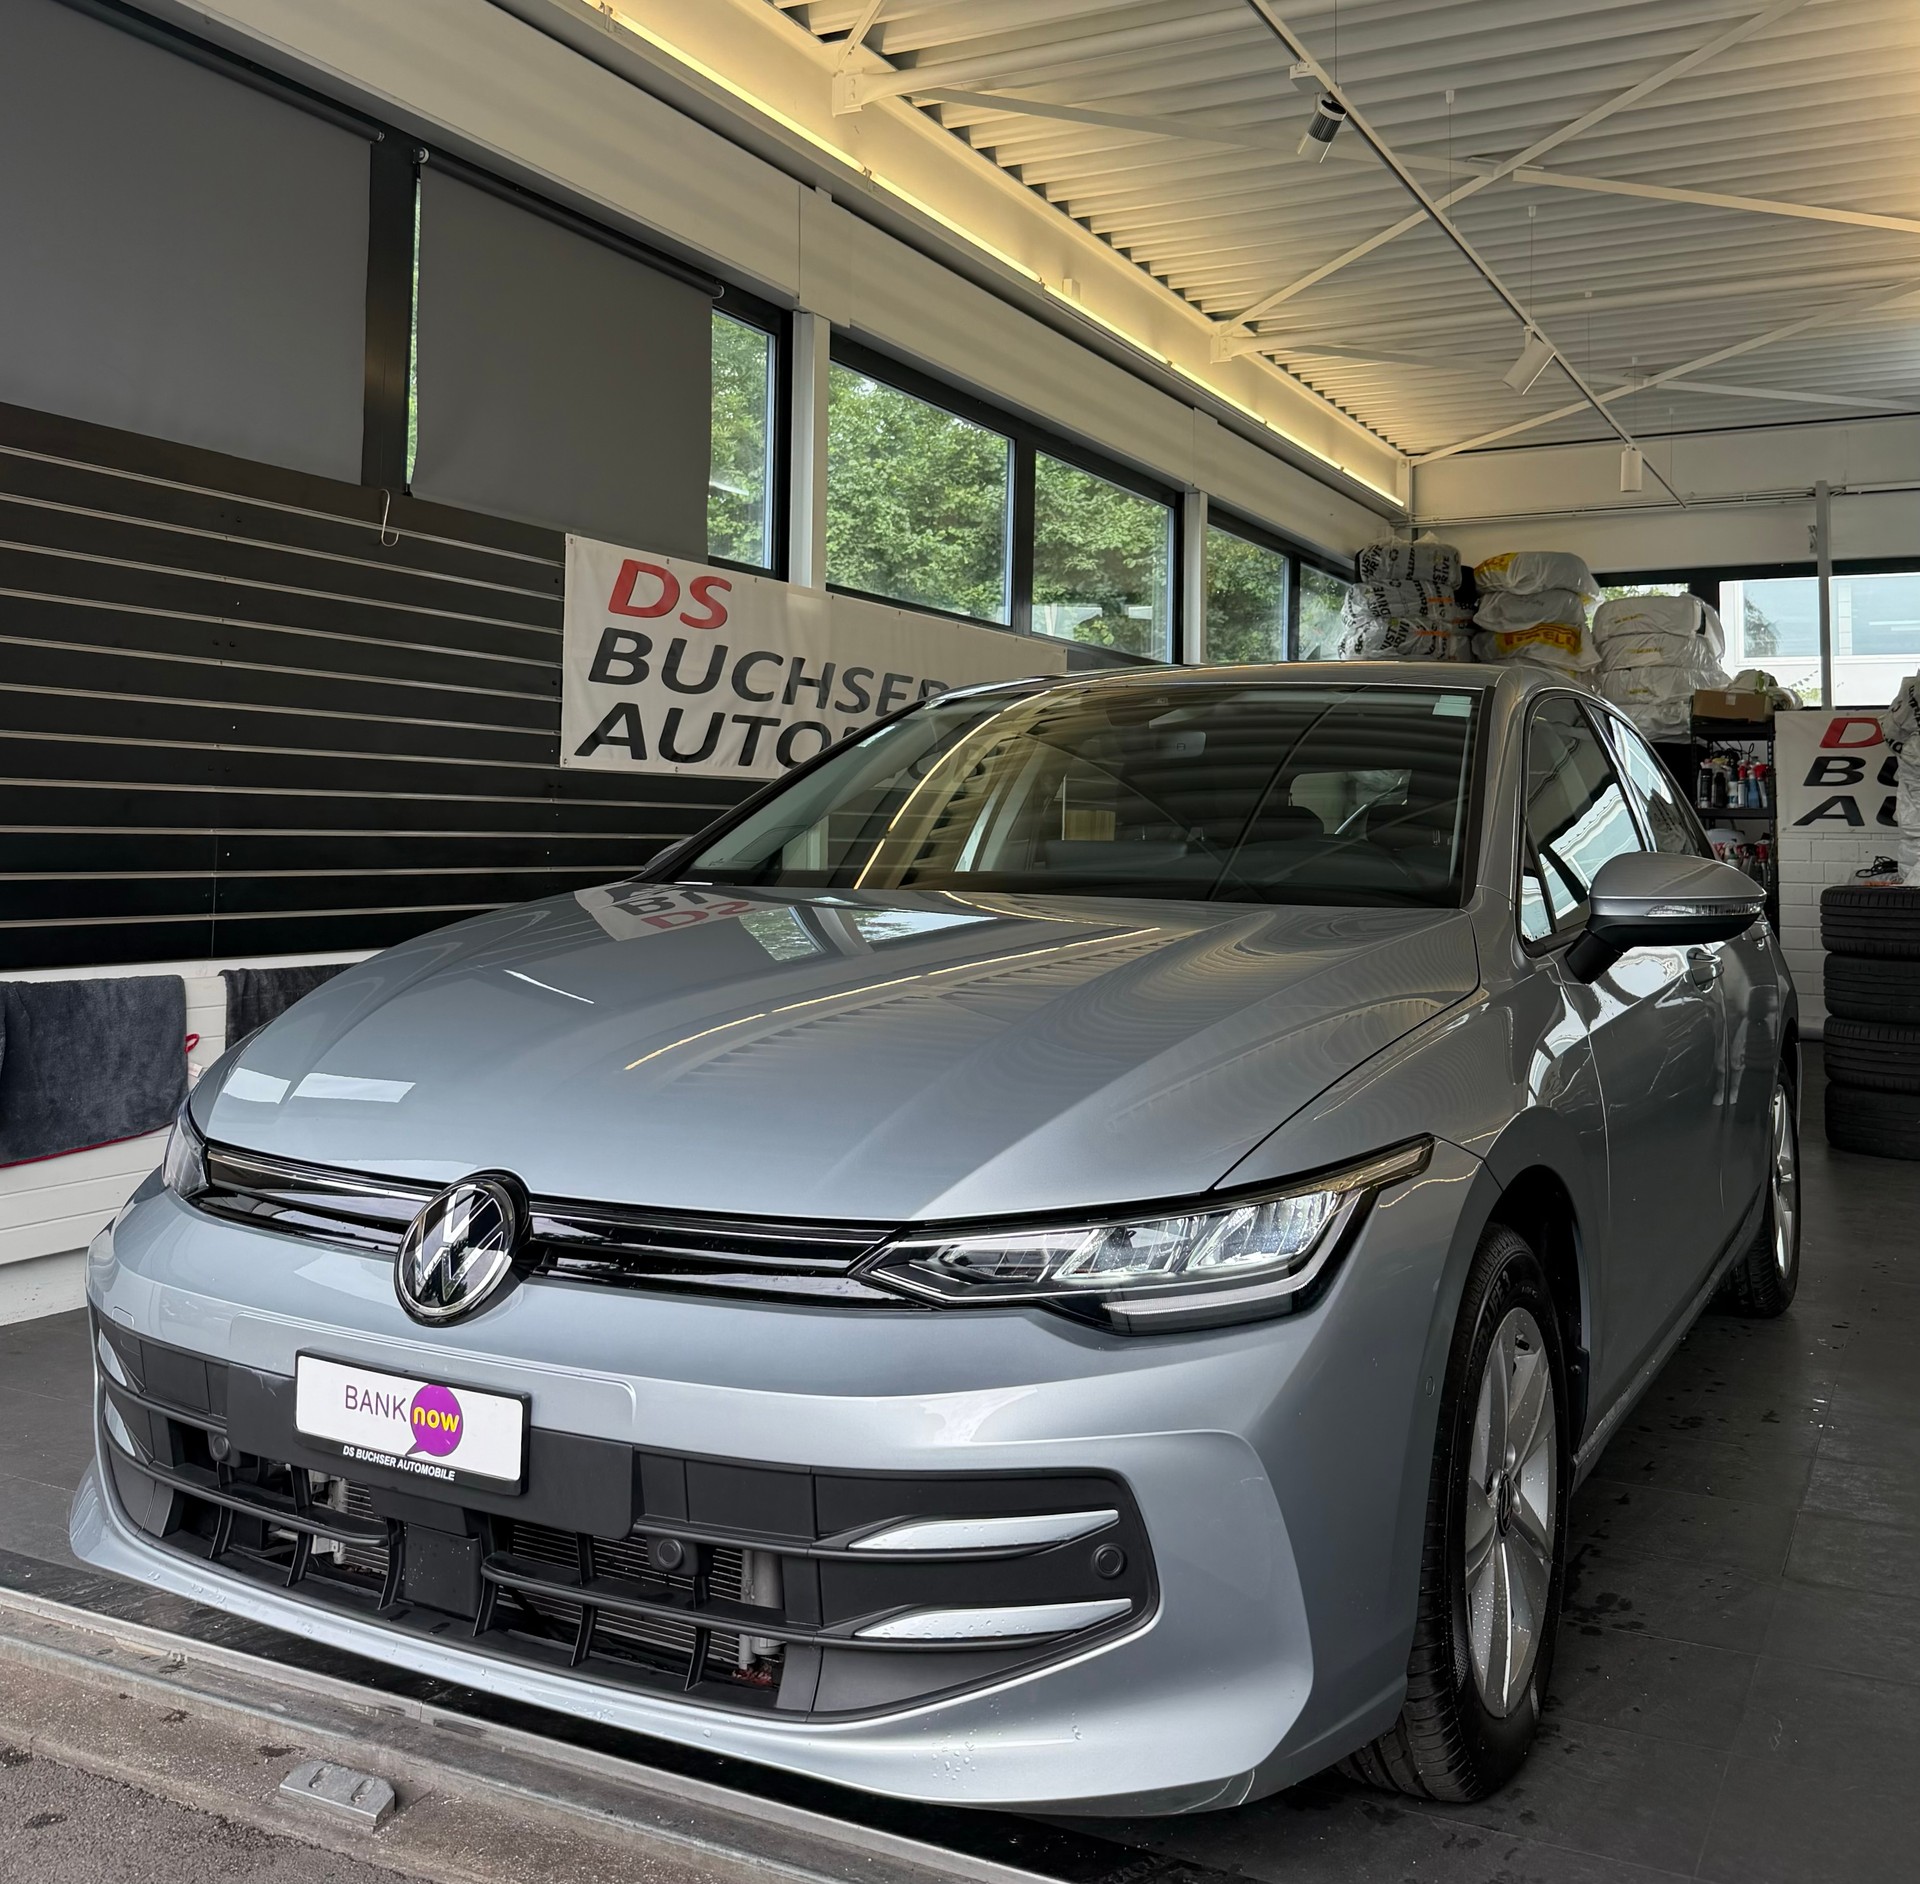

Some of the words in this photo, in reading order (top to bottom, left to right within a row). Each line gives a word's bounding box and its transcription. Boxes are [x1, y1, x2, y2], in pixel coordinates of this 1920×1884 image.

[607, 559, 732, 629] DS
[345, 1384, 407, 1423] BANK
[413, 1407, 459, 1432] now
[343, 1445, 356, 1457] DS
[356, 1448, 396, 1469] BUCHSER
[397, 1459, 456, 1482] AUTOMOBILE
